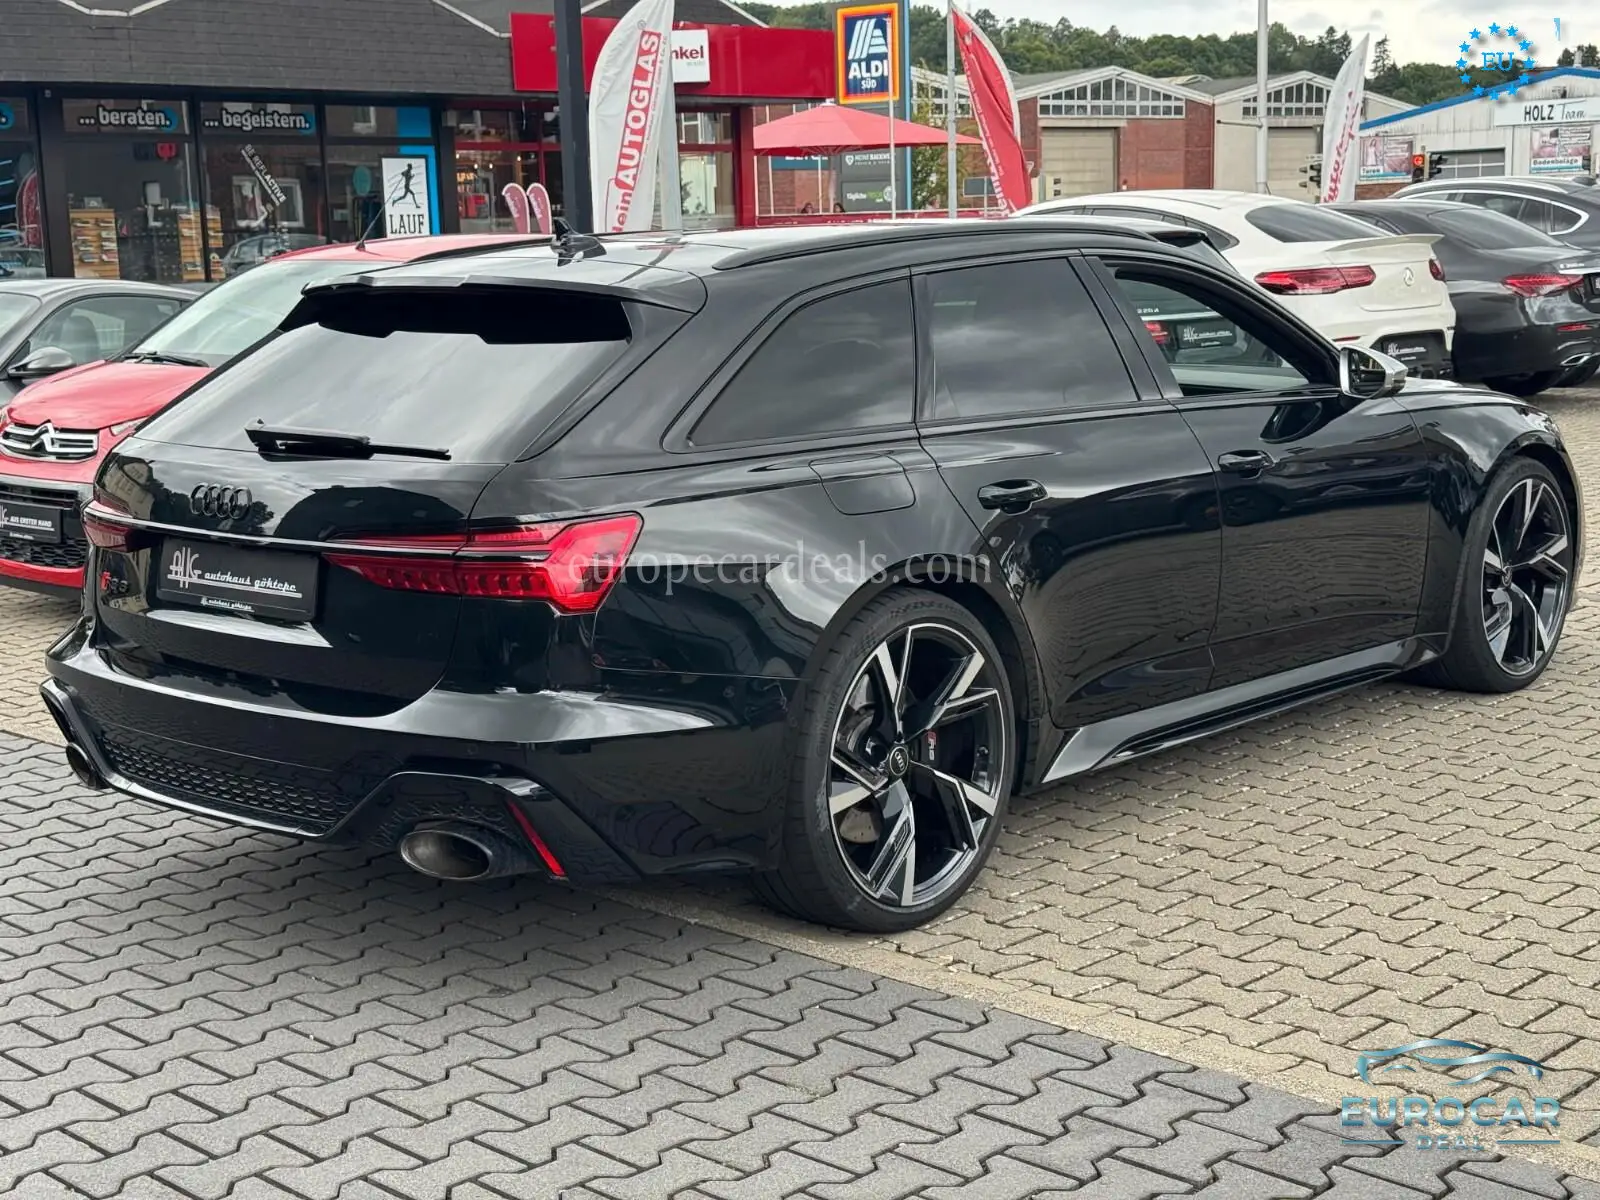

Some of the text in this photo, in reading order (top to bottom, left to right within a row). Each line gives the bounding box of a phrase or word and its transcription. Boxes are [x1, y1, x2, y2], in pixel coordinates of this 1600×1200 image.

[848, 60, 889, 79] ALDI
[861, 79, 877, 90] SÜD
[99, 107, 170, 126] beraten.
[222, 110, 309, 130] begeistern.
[1524, 104, 1554, 121] HOLZ
[389, 213, 424, 235] LAUF
[204, 571, 251, 585] autohaus
[254, 578, 297, 593] göktepe
